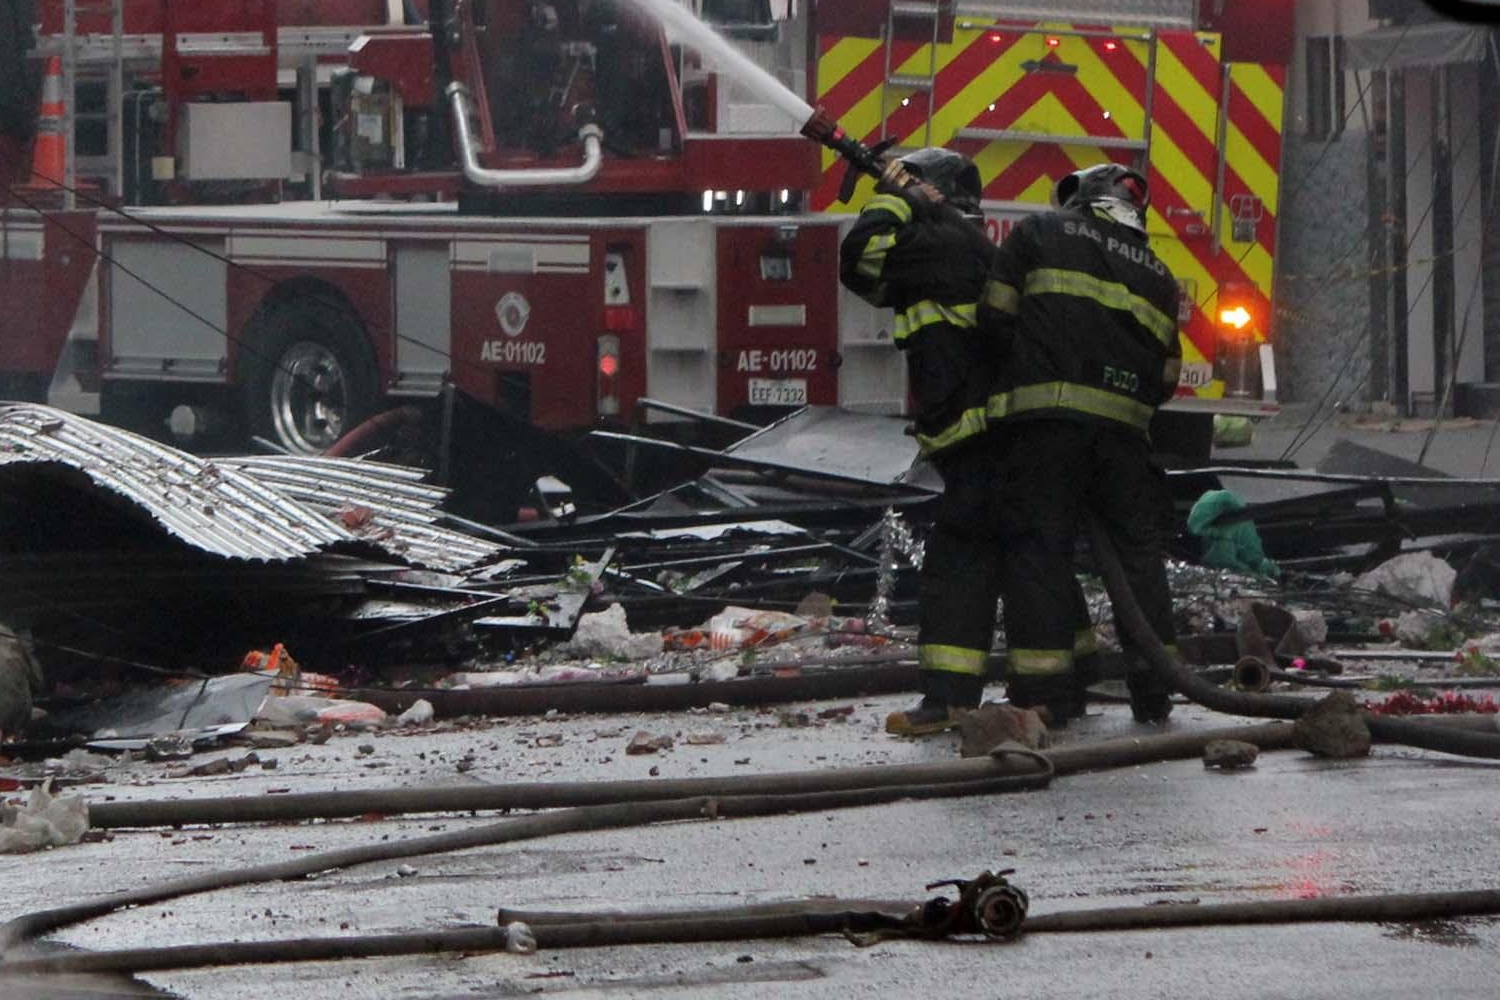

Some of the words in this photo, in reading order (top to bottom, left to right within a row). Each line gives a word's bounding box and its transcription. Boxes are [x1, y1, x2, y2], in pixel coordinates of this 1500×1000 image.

[1107, 237, 1165, 277] PAULO
[481, 339, 546, 365] AE-01102
[737, 349, 817, 372] AE-01102
